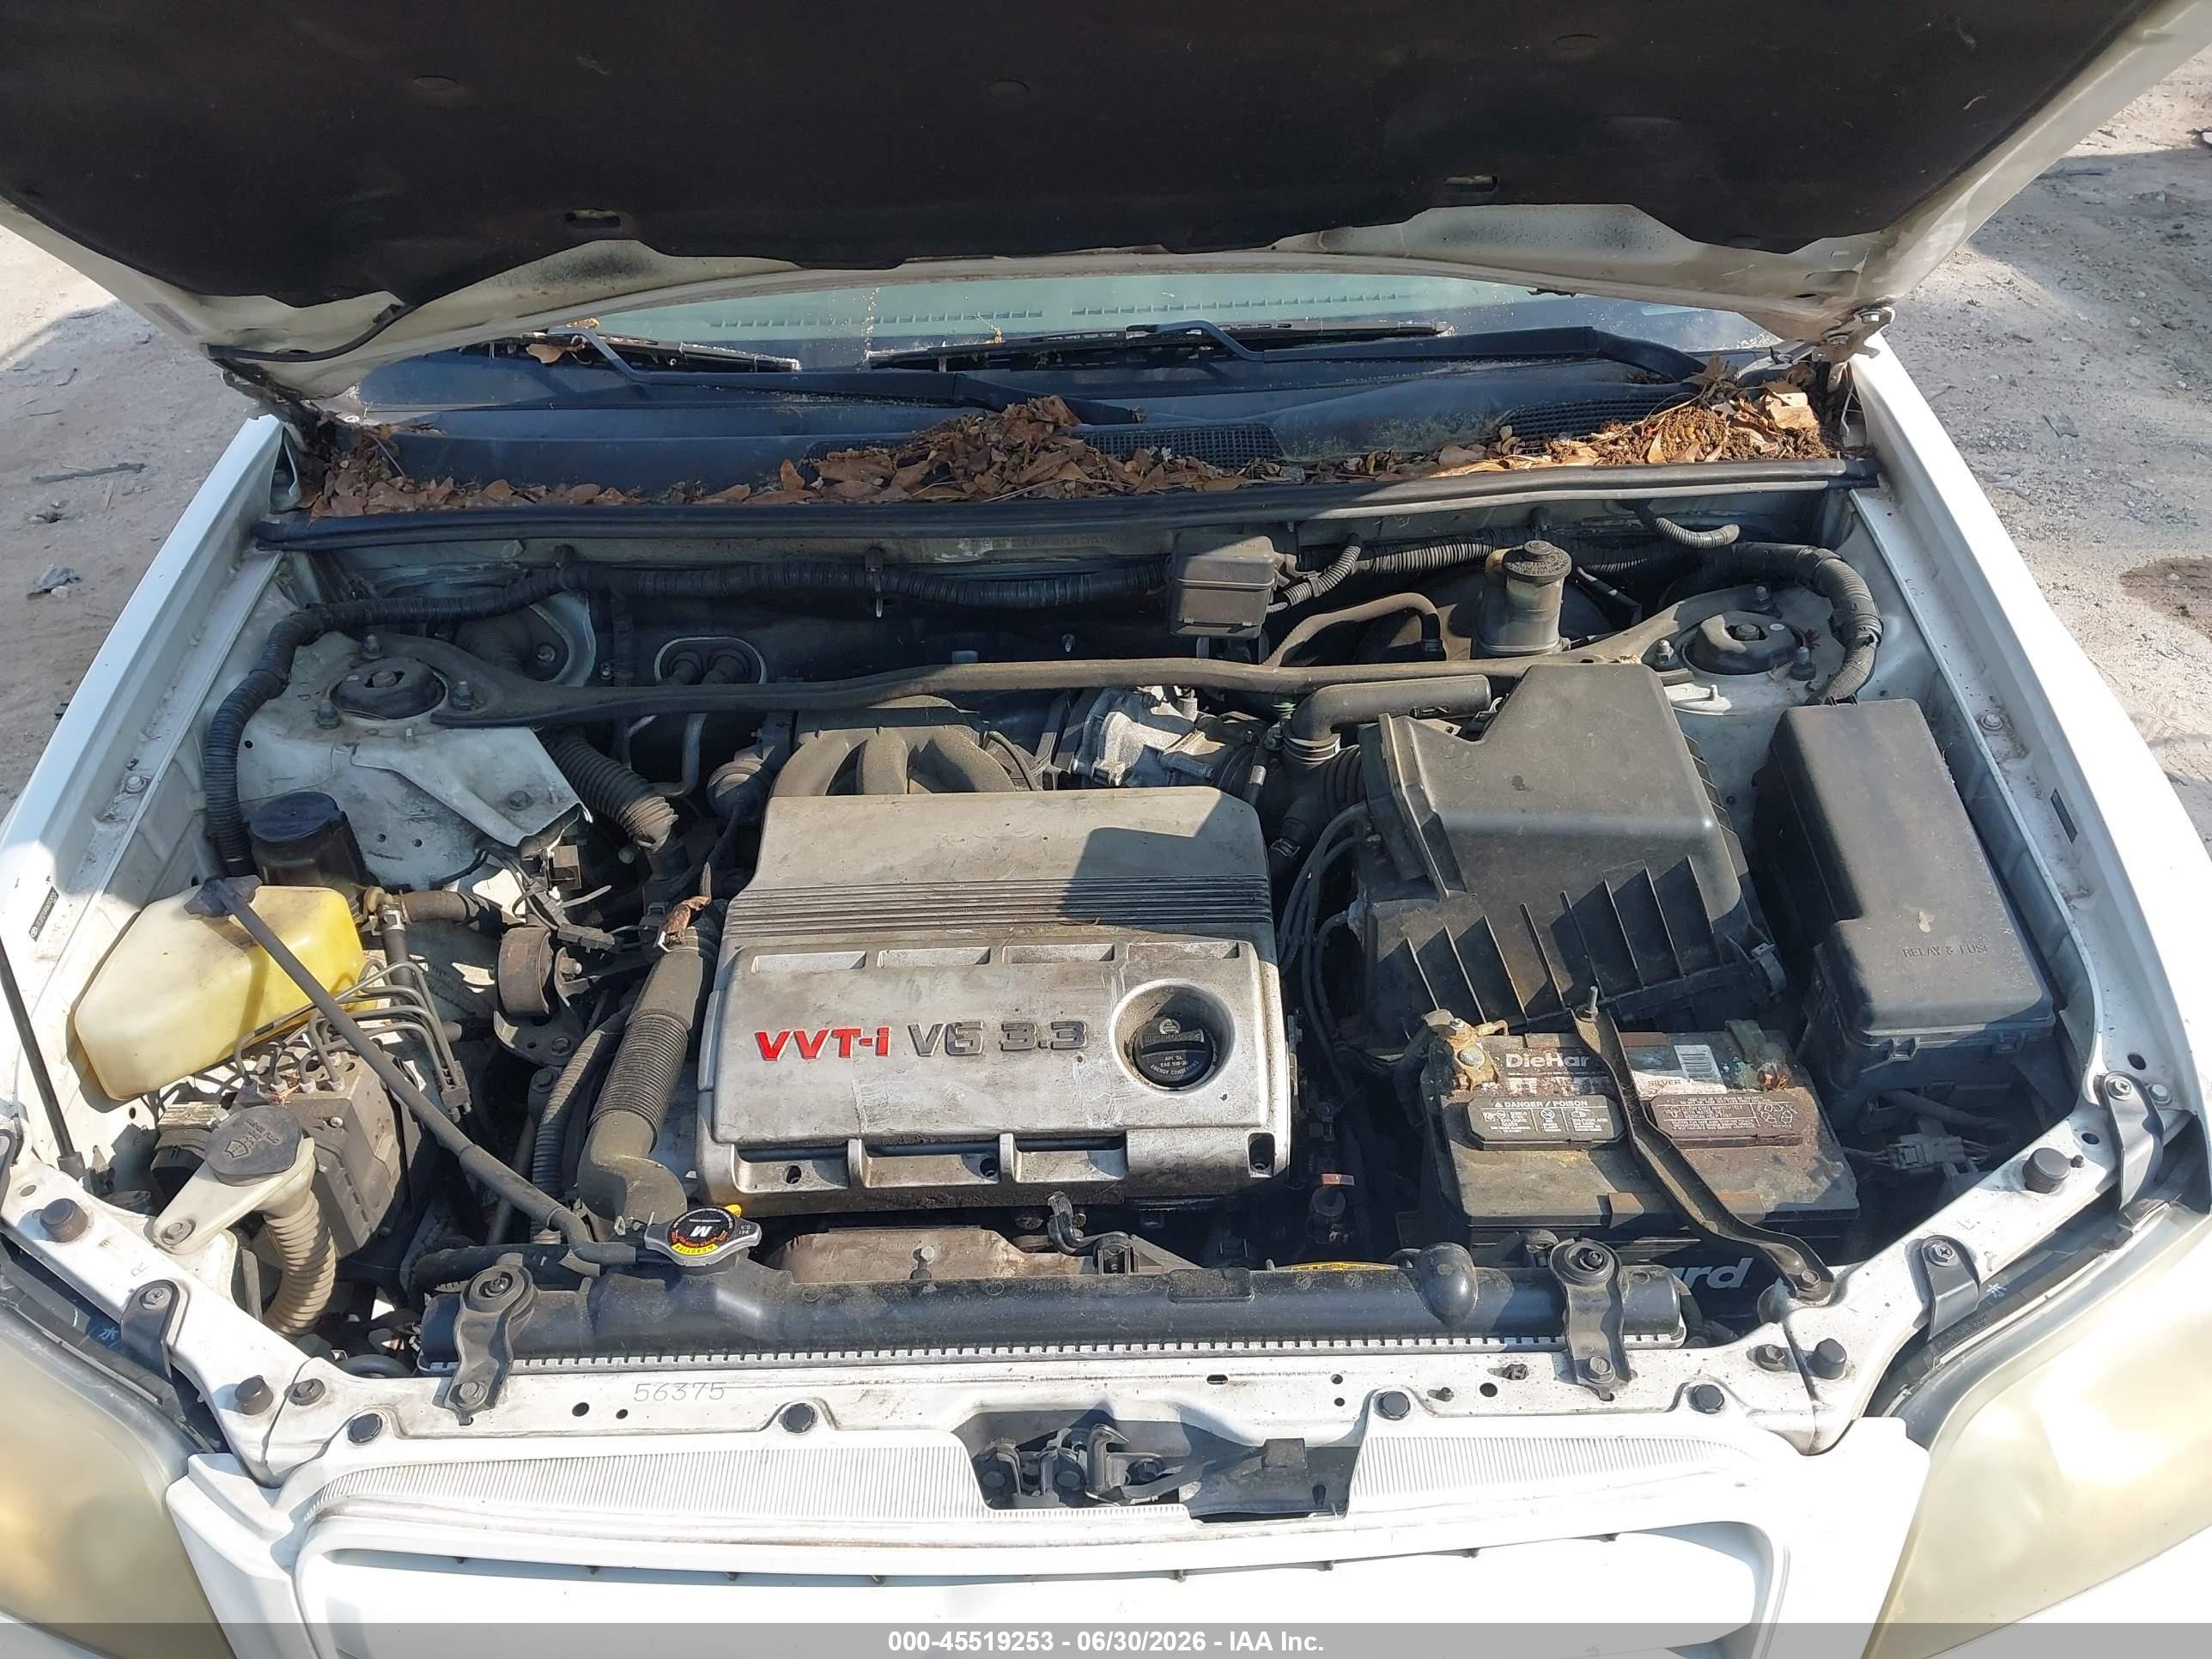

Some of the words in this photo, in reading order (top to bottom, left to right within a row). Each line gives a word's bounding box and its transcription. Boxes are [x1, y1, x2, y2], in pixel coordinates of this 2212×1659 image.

[1903, 946, 1940, 957] RELAY
[1946, 945, 1954, 955] &
[756, 1025, 892, 1061] VVT-i
[908, 1020, 984, 1058] V6
[999, 1019, 1088, 1052] 3.3
[1505, 1053, 1591, 1068] DieHar
[634, 1381, 727, 1402] 56375
